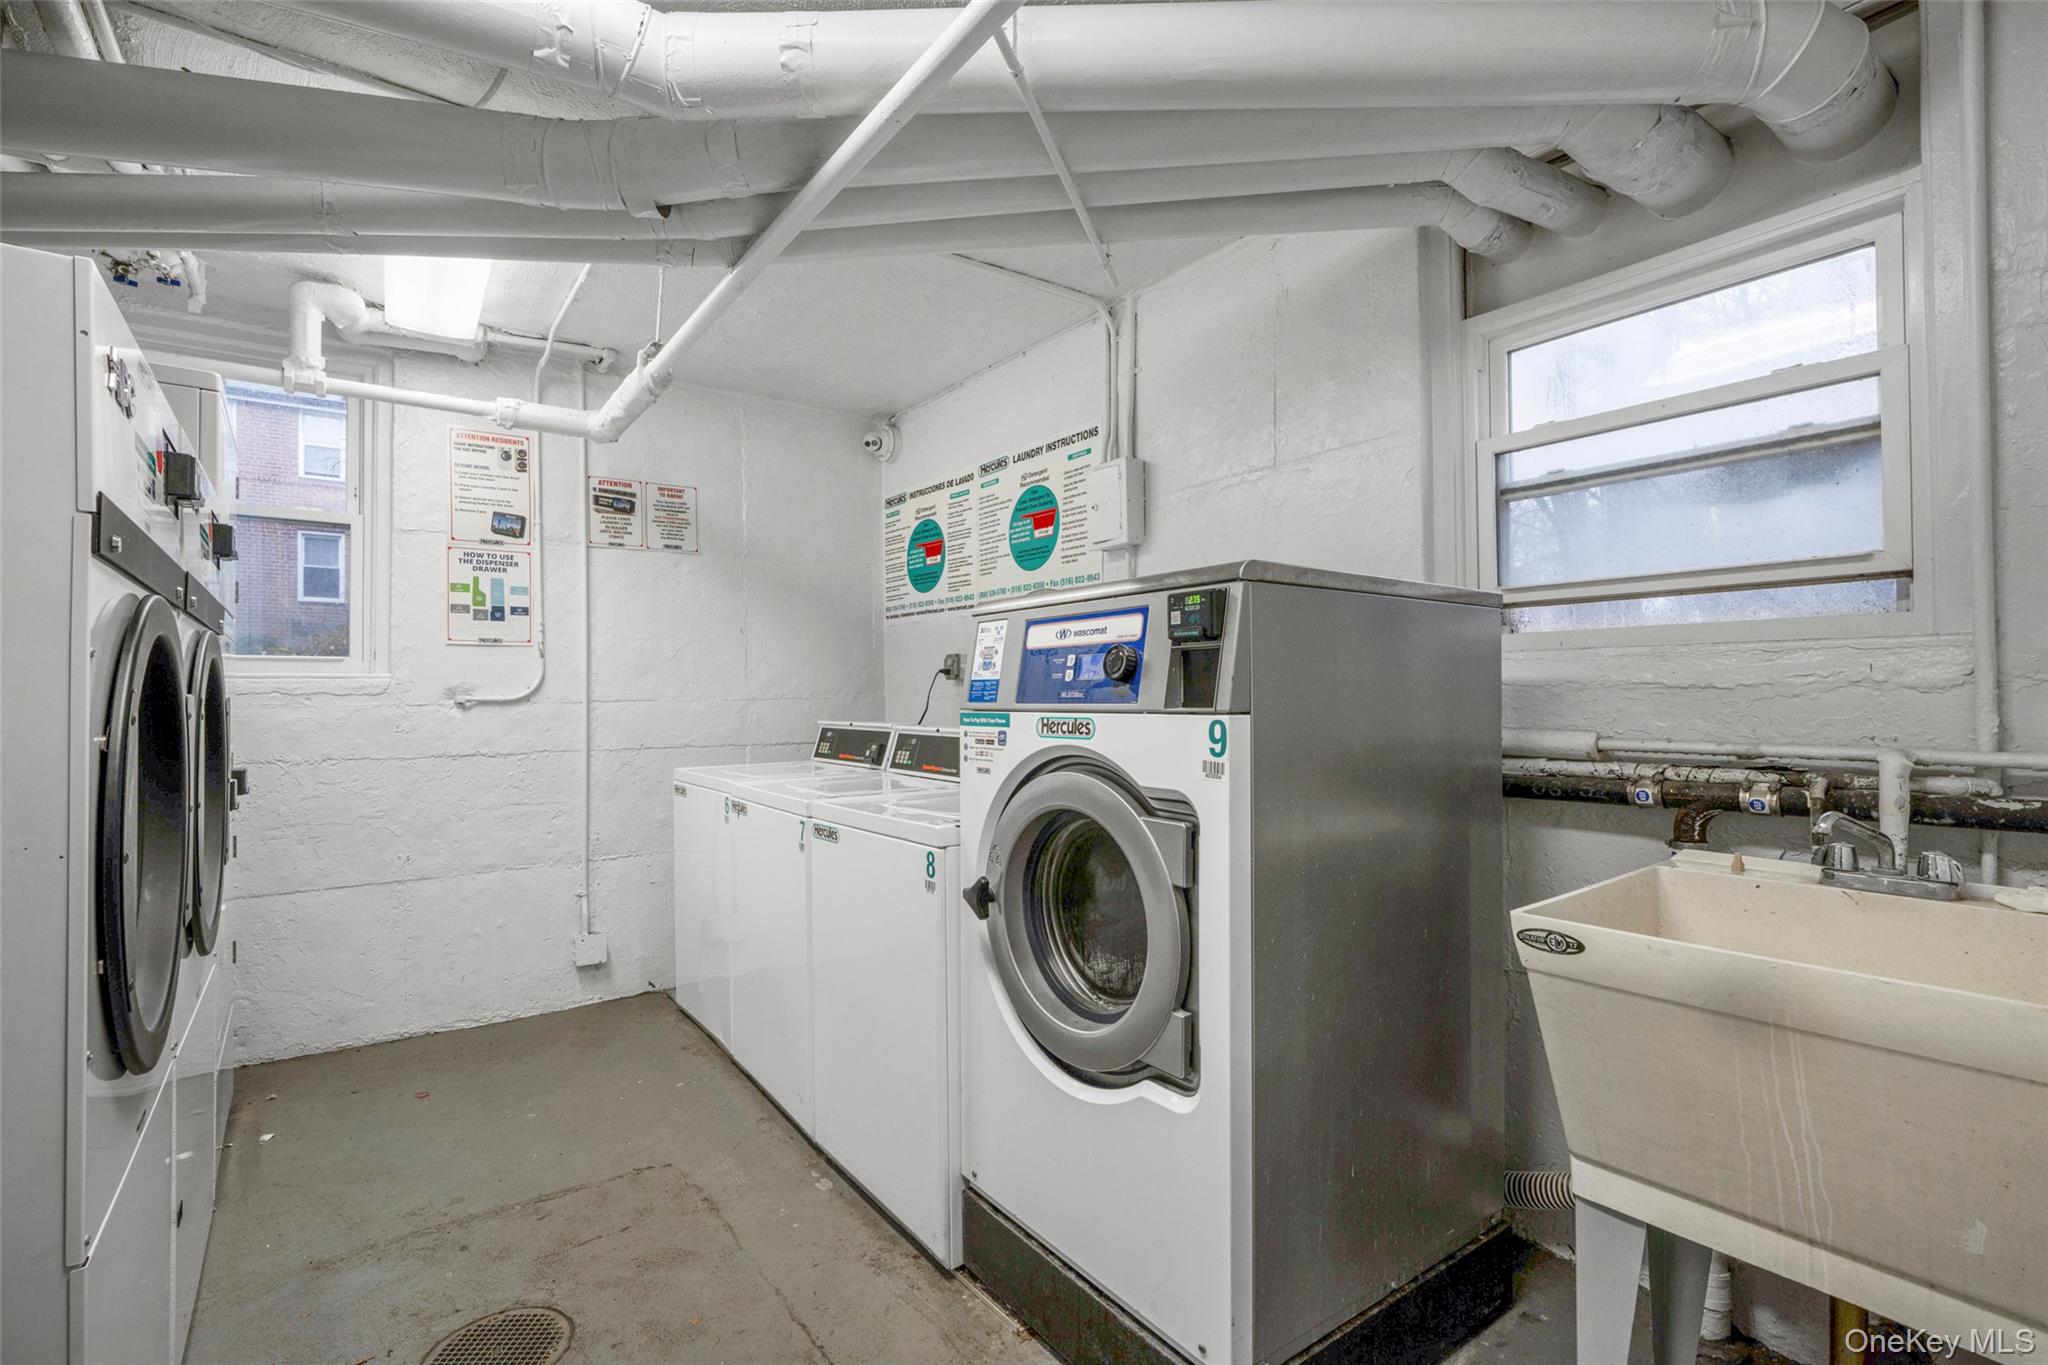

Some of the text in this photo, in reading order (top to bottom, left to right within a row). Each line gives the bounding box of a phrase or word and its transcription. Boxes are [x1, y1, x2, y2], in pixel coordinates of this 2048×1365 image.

[456, 433, 524, 446] ATTENTION RESIDENTS
[1012, 445, 1044, 464] LAUNDRY
[1045, 426, 1100, 452] INSTRUCTIONS
[598, 479, 633, 488] ATTENTION
[909, 482, 945, 500] INSTRUCCIONES
[946, 479, 954, 488] DE
[955, 472, 974, 486] LAVADO
[458, 557, 519, 568] THE DISPENSER
[463, 551, 485, 559] HOW
[472, 565, 508, 573] DRAWER
[1073, 626, 1108, 637] wascomat
[1041, 717, 1091, 735] Hercules
[1208, 719, 1228, 758] 9
[724, 796, 730, 814] 6
[800, 820, 805, 841] 7
[814, 825, 838, 841] Hercules
[926, 851, 936, 879] 8
